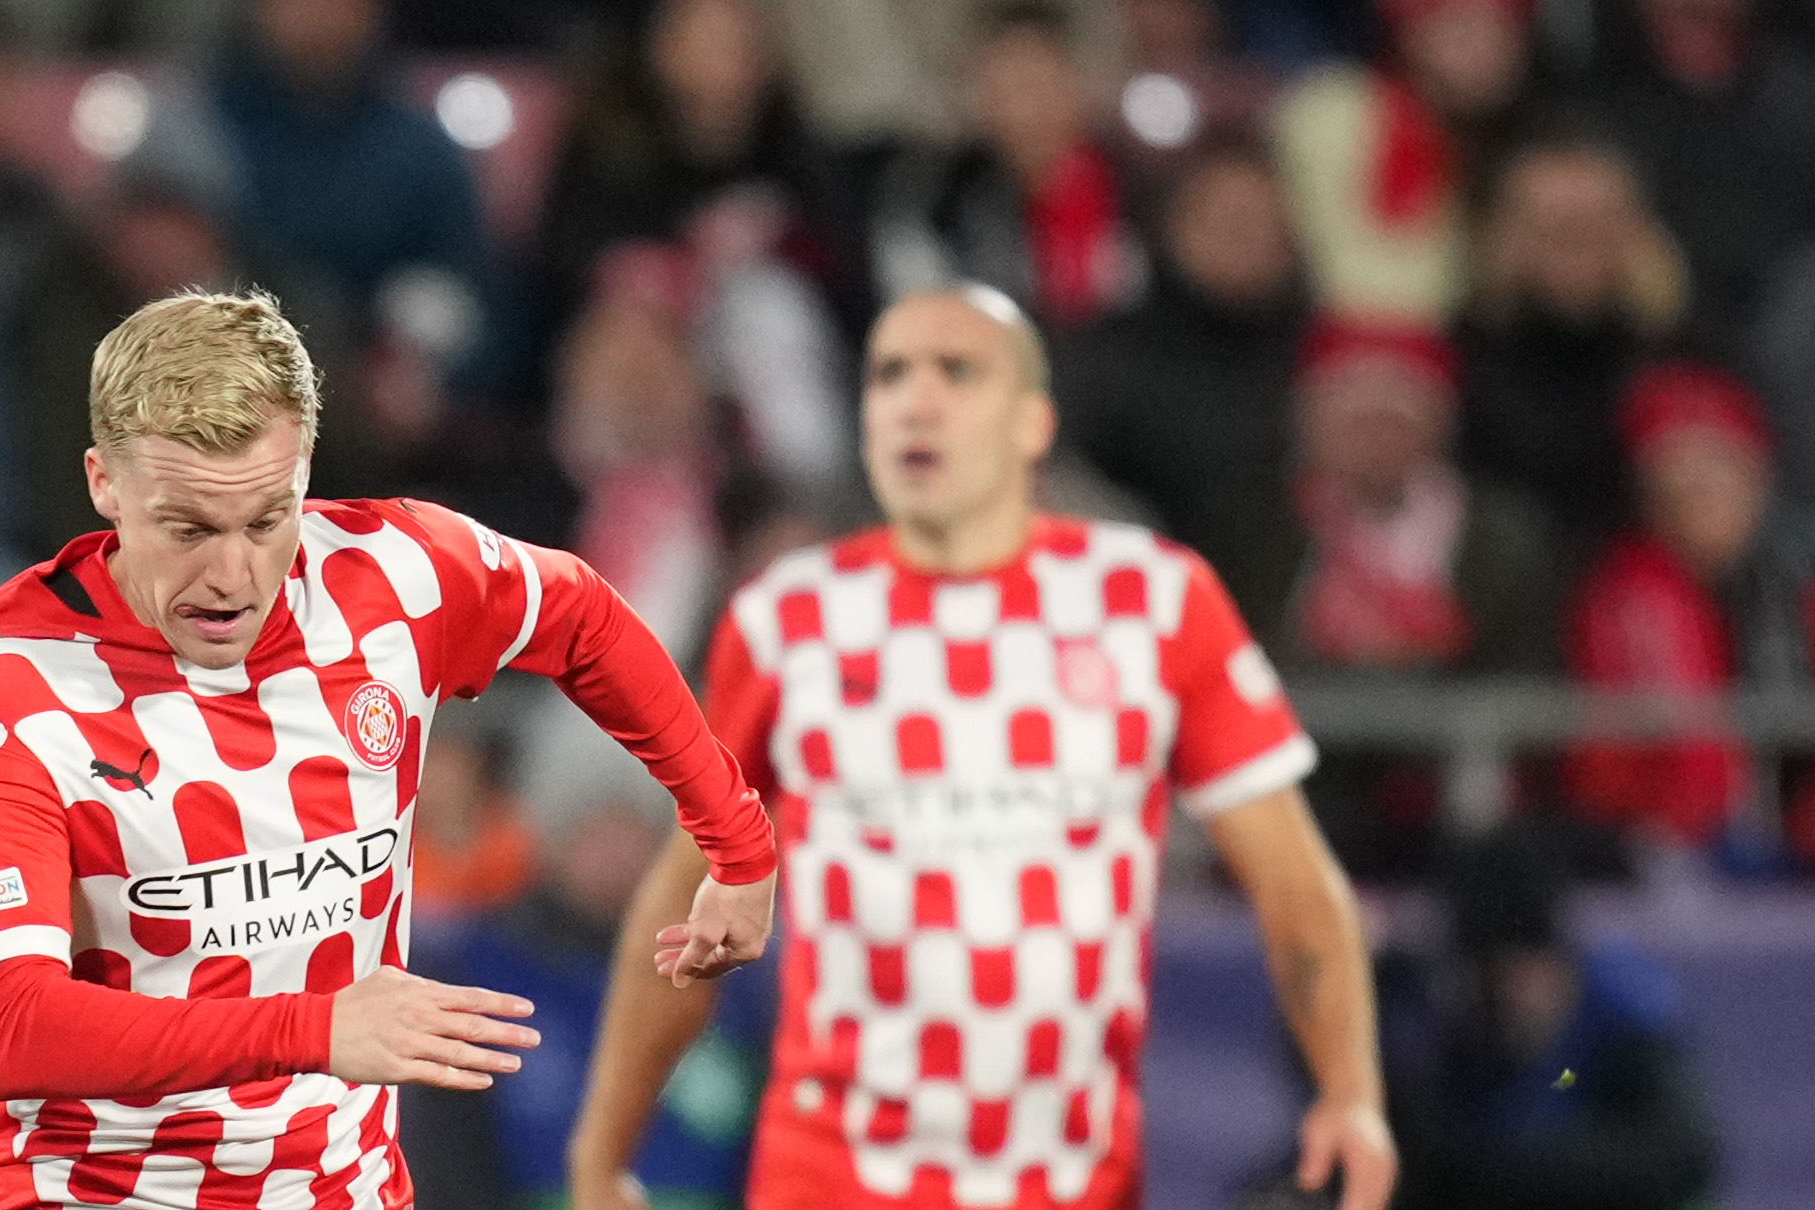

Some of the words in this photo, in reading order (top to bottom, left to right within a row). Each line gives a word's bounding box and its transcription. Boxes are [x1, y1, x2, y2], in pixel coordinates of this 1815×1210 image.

[350, 686, 391, 715] GIRONA
[128, 827, 399, 911] ETIHAD
[201, 897, 355, 950] AIRWAYS
